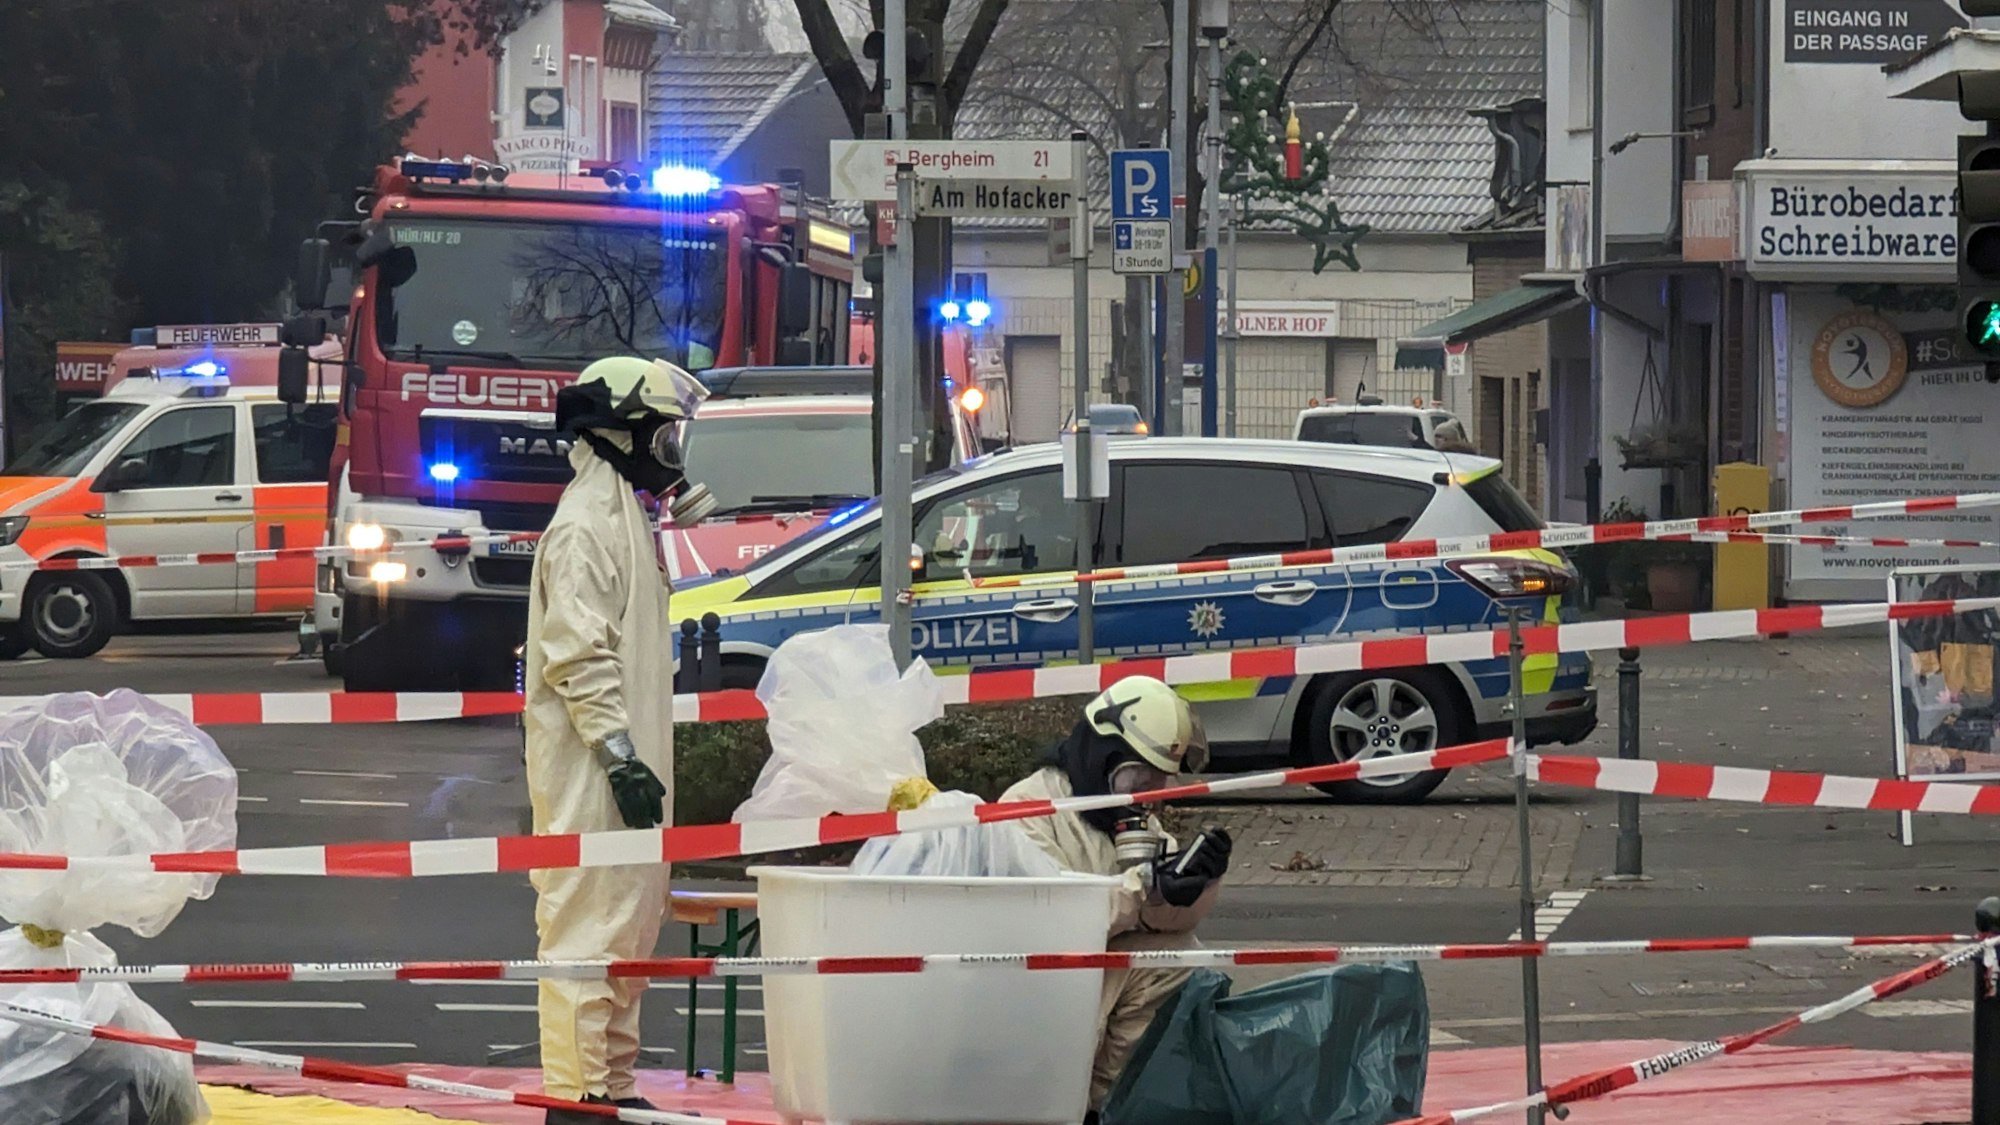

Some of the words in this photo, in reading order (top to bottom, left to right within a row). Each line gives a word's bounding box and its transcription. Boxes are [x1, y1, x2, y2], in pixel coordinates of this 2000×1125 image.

[1793, 10, 1882, 27] EINGANG
[1888, 10, 1909, 27] IN
[1793, 35, 1833, 51] DER
[1839, 35, 1928, 51] PASSAGE
[500, 137, 550, 153] MARCO
[553, 137, 590, 156] POLO
[907, 150, 995, 170] Bergheim
[1034, 150, 1049, 167] 21
[1124, 160, 1157, 215] P
[931, 184, 964, 208] Am
[975, 183, 1071, 209] Hofacker
[446, 231, 461, 244] 20
[1126, 256, 1163, 267] Stunde
[1293, 317, 1327, 332] HOF
[173, 328, 261, 342] FEUERWEHR
[1921, 373, 1953, 385] HIER
[1956, 372, 1969, 383] IN
[1822, 415, 1912, 424] KRANKENGYMNASTIK
[1915, 415, 1929, 424] AM
[1822, 431, 1928, 439] KINDERPHYSIOTHERAPIE
